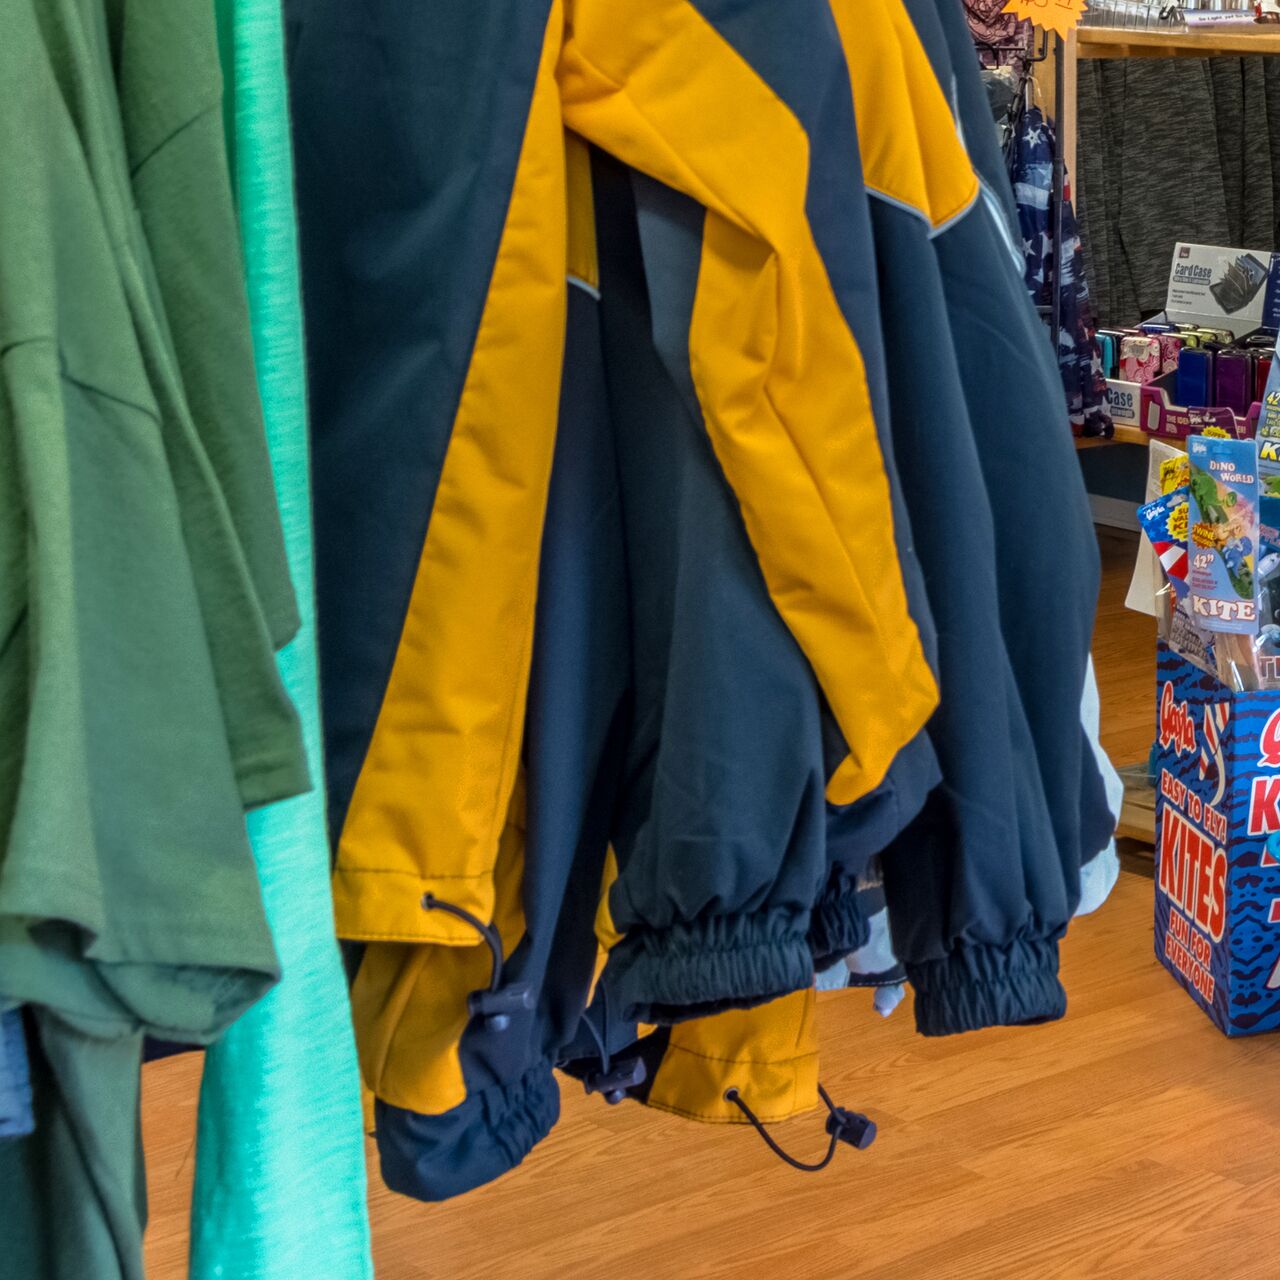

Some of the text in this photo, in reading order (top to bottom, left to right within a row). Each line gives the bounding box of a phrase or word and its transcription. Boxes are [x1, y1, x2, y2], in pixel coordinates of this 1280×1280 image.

[1175, 262, 1212, 279] Card Case
[1106, 387, 1133, 408] Case
[1192, 596, 1256, 621] KITE
[1160, 681, 1196, 757] Gayla
[1161, 768, 1227, 846] EASY TO FLY!
[1159, 803, 1228, 942] KITES
[1165, 937, 1215, 1005] EVERYONE
[1168, 909, 1212, 969] FUN FOR
